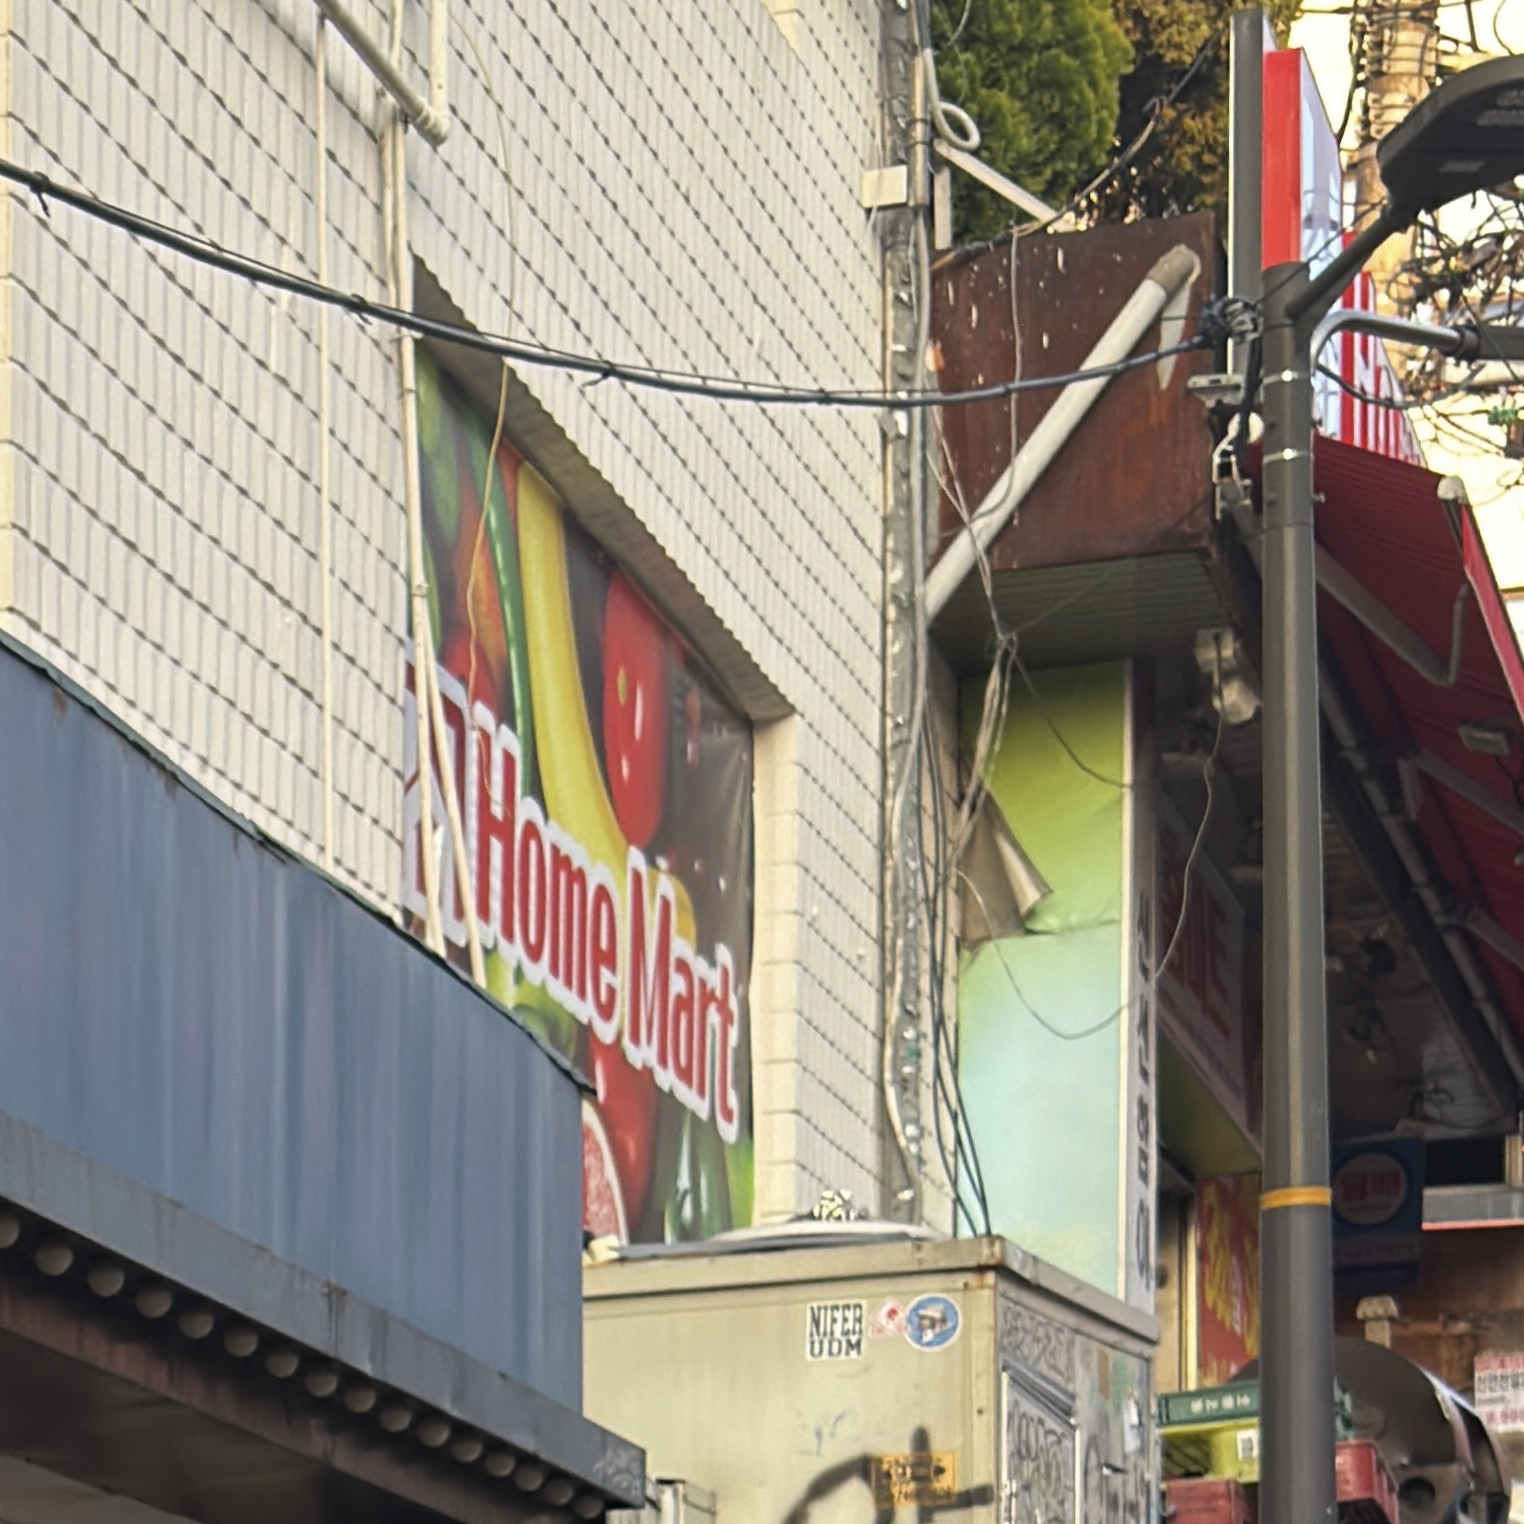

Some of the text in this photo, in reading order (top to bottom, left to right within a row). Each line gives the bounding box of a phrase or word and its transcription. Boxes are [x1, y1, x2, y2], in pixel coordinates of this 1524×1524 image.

[473, 705, 620, 1034] Home
[628, 850, 740, 1135] Mart
[809, 1303, 863, 1338] NIFER
